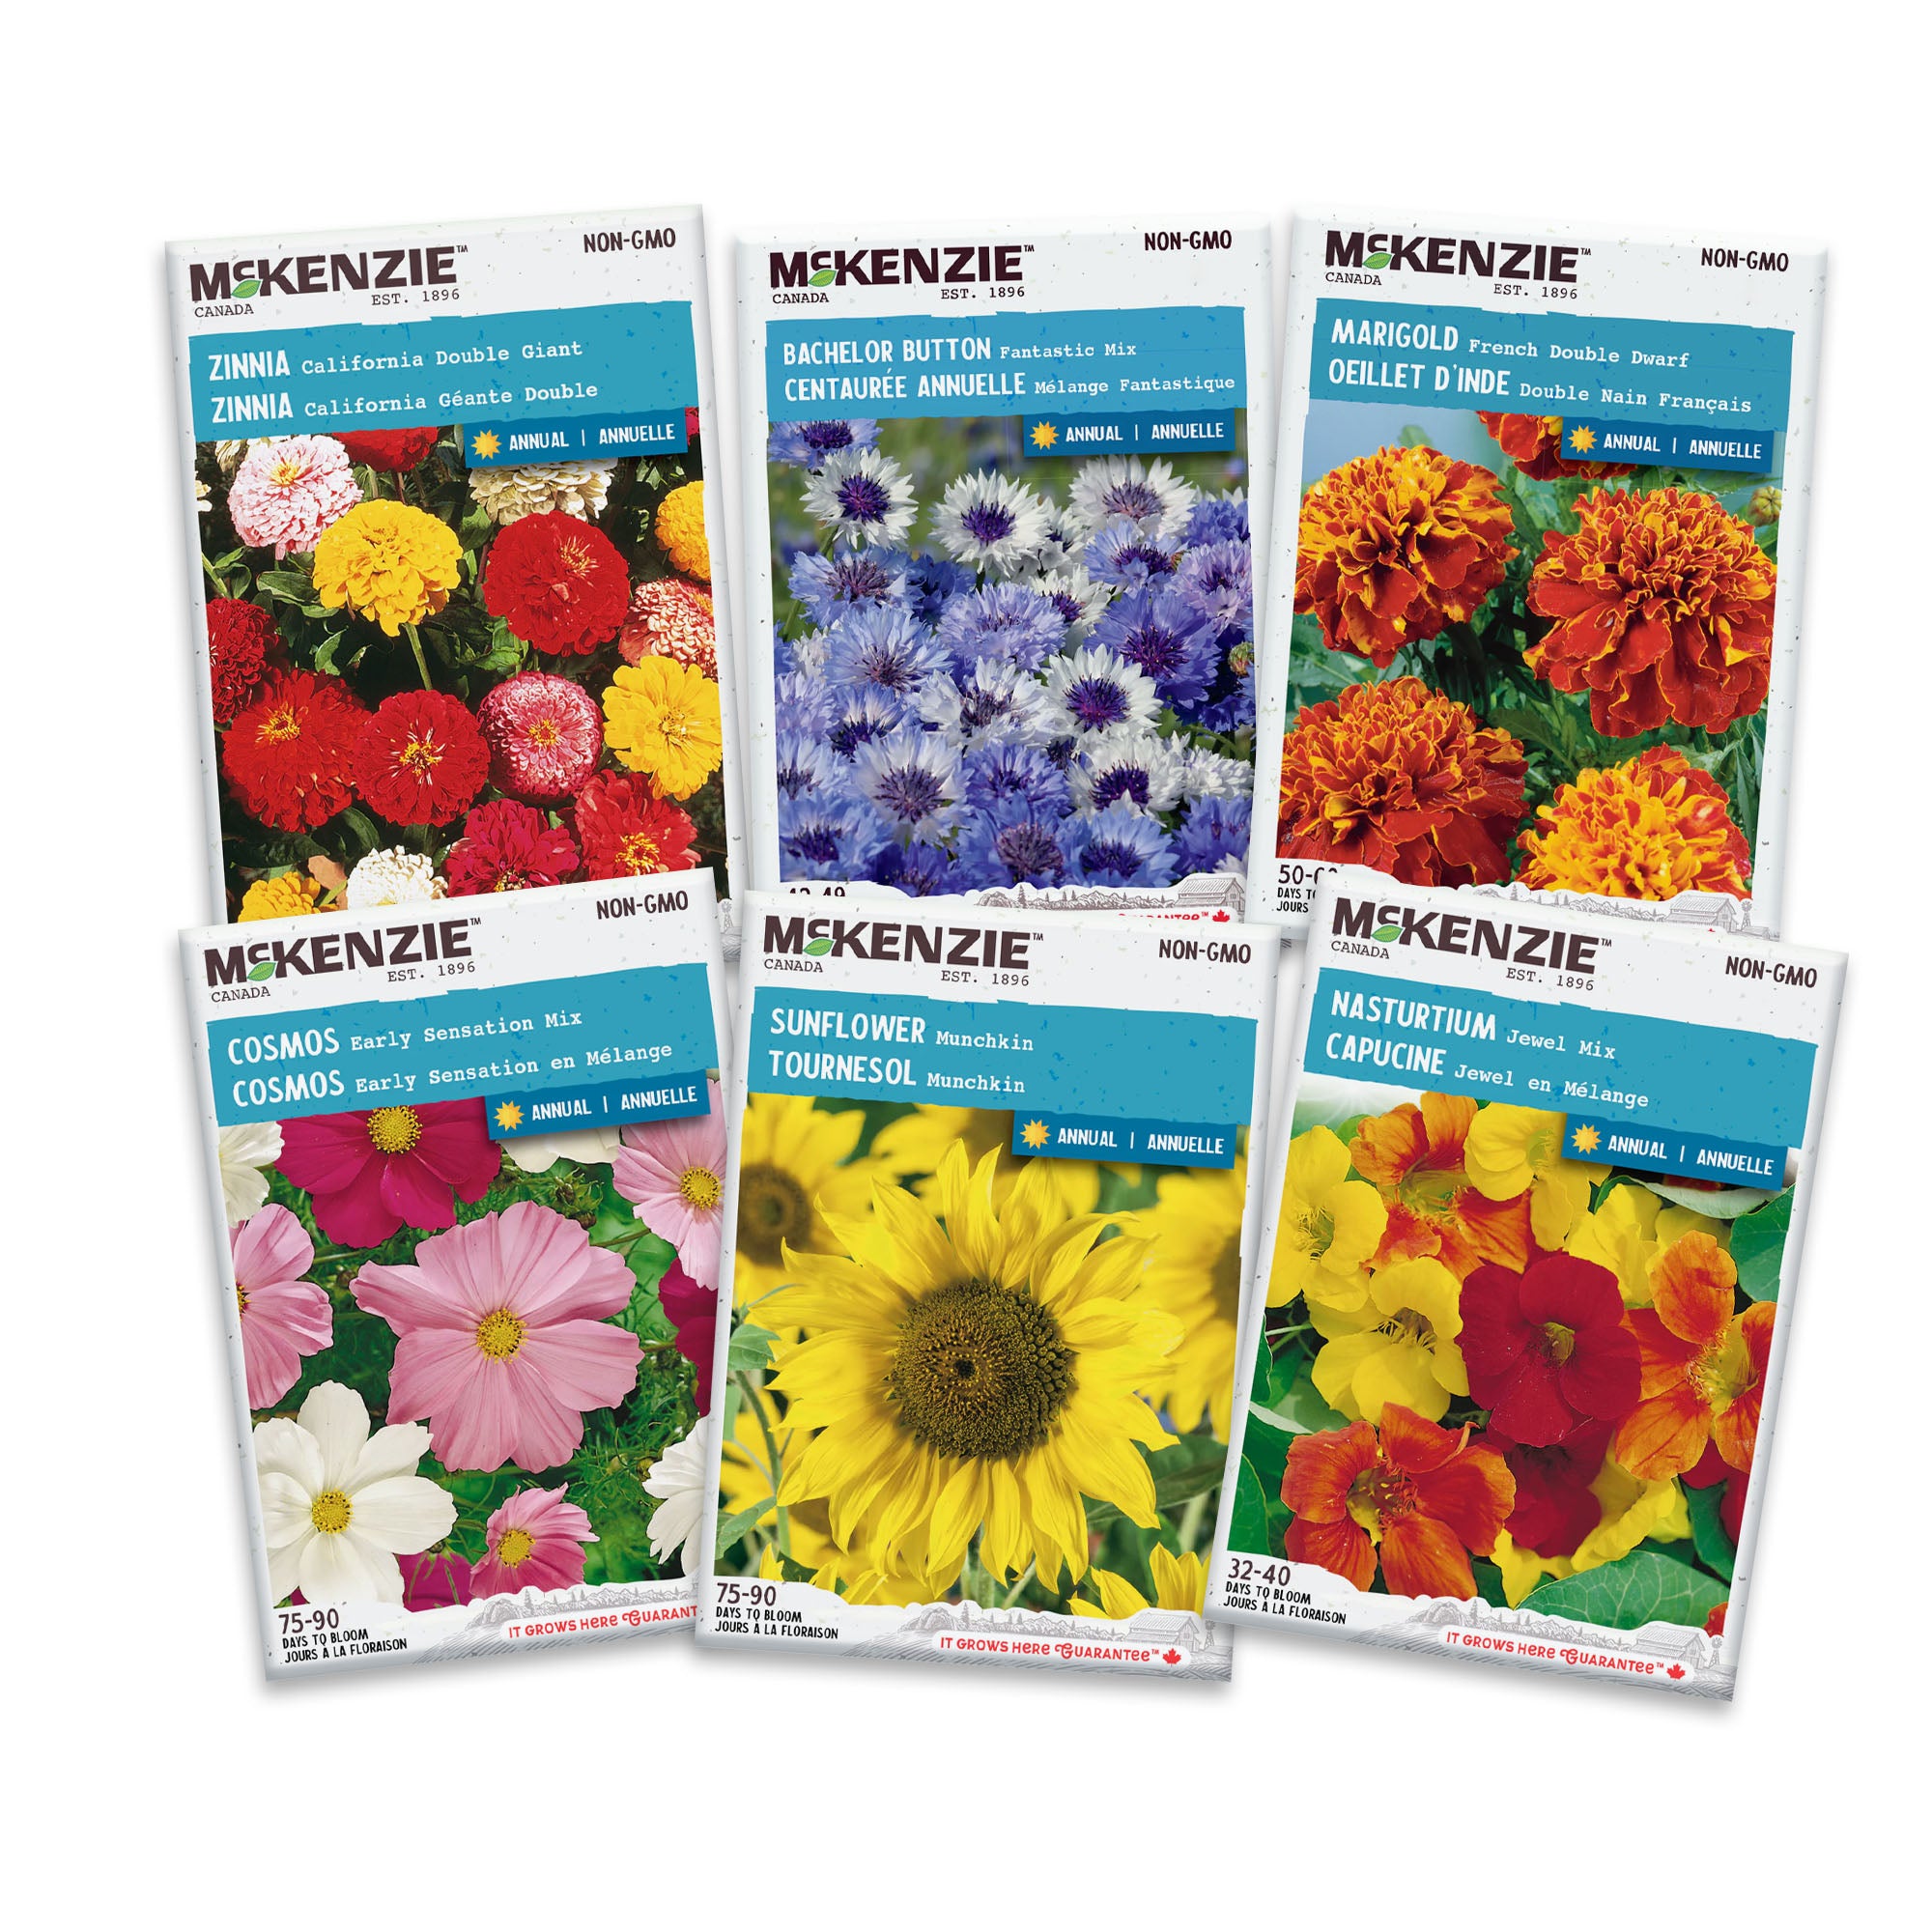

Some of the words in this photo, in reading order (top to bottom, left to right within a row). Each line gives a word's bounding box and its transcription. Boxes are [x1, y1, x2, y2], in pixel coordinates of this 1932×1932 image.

[583, 227, 676, 253] NON-GMO
[1144, 229, 1233, 251] NON-GMO
[1700, 247, 1789, 272] NON-GMO
[1324, 271, 1382, 286] CANADA
[1493, 283, 1528, 297] EST.
[1541, 286, 1577, 299] 1896
[371, 293, 409, 306] EST.
[422, 288, 460, 302] 1896
[772, 292, 830, 304] CANADA
[940, 288, 977, 300] EST.
[989, 286, 1025, 298] 1896
[194, 303, 253, 318] CANADA
[783, 339, 894, 366] BACHELOR
[902, 336, 991, 362] BUTTON
[1000, 342, 1094, 359] Fantastic
[1104, 343, 1137, 356] Mix
[1330, 318, 1459, 352] MARIGOLD
[1468, 338, 1538, 357] French
[1549, 344, 1620, 363] Double
[1631, 350, 1690, 368] Dwarf
[208, 350, 291, 382] ZINNIA
[301, 351, 424, 375] California
[435, 346, 510, 365] Double
[522, 340, 583, 359] Giant
[784, 367, 908, 402] CENTAURÉE
[917, 372, 1026, 398] ANNUELLE
[1035, 380, 1109, 397] Mélange
[1120, 375, 1236, 393] Fantastique
[1328, 357, 1426, 389] OEILLET
[1434, 363, 1511, 396] D'INDE
[1519, 383, 1589, 401] Double
[1601, 388, 1647, 406] Nain
[1659, 392, 1751, 415] Français
[211, 391, 294, 424] ZINNIA
[304, 393, 427, 417] California
[439, 388, 513, 408] Géante
[525, 382, 598, 402] Double
[509, 431, 570, 451] ANNUAL
[599, 423, 675, 444] ANNUELLE
[1065, 425, 1123, 442] ANNUAL
[1151, 422, 1224, 440] ANNUELLE
[1604, 433, 1661, 452] ANNUAL
[1689, 439, 1762, 460] ANNUELLE
[1278, 864, 1338, 886] 50-
[596, 890, 689, 920] NON-GMO
[1277, 887, 1302, 899] DAYS
[1276, 900, 1309, 914] JOURS
[1158, 938, 1252, 964] NON-GMO
[1330, 940, 1390, 959] CANADA
[386, 968, 424, 982] EST.
[438, 960, 475, 977] 1896
[763, 958, 823, 973] CANADA
[941, 970, 978, 983] EST.
[992, 973, 1029, 986] 1896
[1725, 955, 1818, 988] NON-GMO
[1506, 967, 1543, 983] EST.
[1556, 975, 1594, 991] 1896
[211, 985, 271, 1003] CANADA
[227, 1027, 340, 1065] COSMOS
[350, 1031, 412, 1051] Early
[423, 1016, 534, 1042] Sensation
[544, 1009, 582, 1029] Mix
[770, 1008, 926, 1044] SUNFLOWER
[935, 1030, 1034, 1051] Munchkin
[1330, 989, 1496, 1041] NASTURTIUM
[1506, 1029, 1566, 1052] Jewel
[1577, 1039, 1616, 1060] Mix
[232, 1068, 345, 1108] COSMOS
[355, 1072, 416, 1094] Early
[428, 1059, 539, 1085] Sensation
[551, 1056, 576, 1070] en
[585, 1045, 672, 1066] Mélange
[768, 1049, 917, 1086] TOURNESOL
[926, 1072, 1025, 1094] Munchkin
[1325, 1032, 1447, 1076] CAPUCINE
[1454, 1064, 1514, 1087] Jewel
[1527, 1078, 1551, 1093] en
[1563, 1080, 1649, 1110] Mélange
[532, 1098, 592, 1121] ANNUAL
[621, 1086, 697, 1110] ANNUELLE
[1057, 1127, 1118, 1148] ANNUAL
[1147, 1133, 1224, 1154] ANNUELLE
[1607, 1135, 1667, 1159] ANNUAL
[1696, 1149, 1775, 1176] ANNUELLE
[1227, 1557, 1291, 1587] 32-40
[717, 1582, 777, 1607] 75-90
[1225, 1580, 1251, 1596] DAYS
[1256, 1585, 1270, 1599] TO
[1273, 1588, 1311, 1605] BLOOM
[278, 1607, 339, 1634] 75-90
[715, 1605, 742, 1619] DAYS
[746, 1607, 761, 1620] TO
[763, 1608, 803, 1623] BLOOM
[1223, 1595, 1258, 1611] JOURS
[1272, 1602, 1285, 1616] LA
[1289, 1605, 1347, 1625] FLORAISON
[282, 1635, 308, 1650] DAYS
[311, 1633, 327, 1645] TO
[329, 1628, 369, 1644] BLOOM
[509, 1626, 522, 1638] IT
[525, 1619, 578, 1636] GROWS
[714, 1620, 750, 1634] JOURS
[764, 1623, 778, 1635] LA
[781, 1624, 838, 1639] FLORAISON
[284, 1648, 319, 1663] JOURS
[332, 1645, 347, 1658] LA
[350, 1637, 408, 1656] FLORAISON
[940, 1636, 953, 1649] IT
[955, 1637, 1009, 1653] GROWS
[1446, 1632, 1460, 1643] IT
[1462, 1634, 1515, 1653] GROWS
